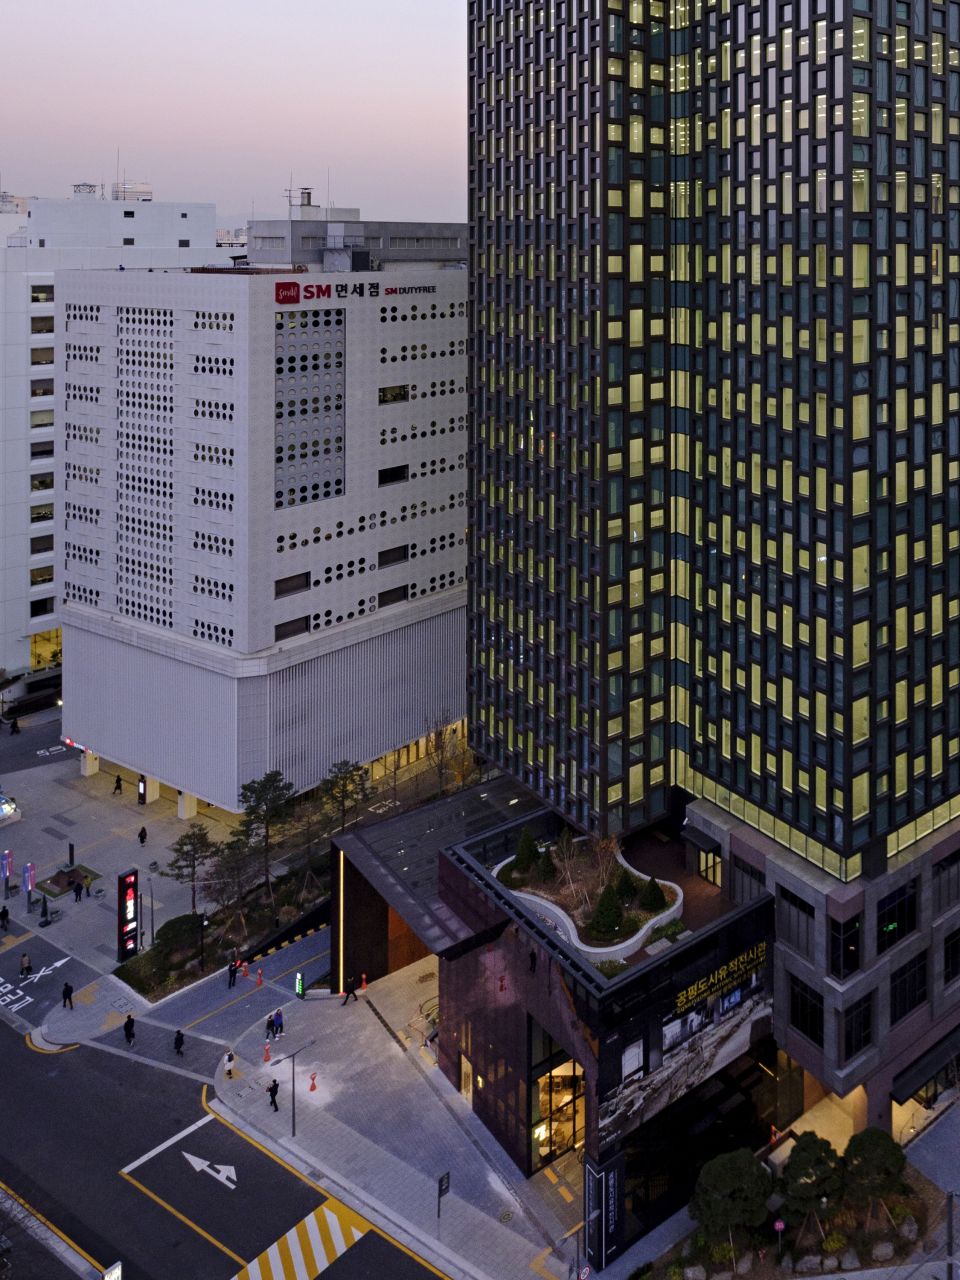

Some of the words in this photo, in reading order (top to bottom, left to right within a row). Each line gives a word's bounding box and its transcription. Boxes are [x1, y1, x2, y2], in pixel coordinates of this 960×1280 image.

[303, 284, 332, 300] SM
[335, 282, 380, 299] 면세점
[384, 287, 398, 296] SM
[675, 941, 768, 1007] 공평도시유적전시관
